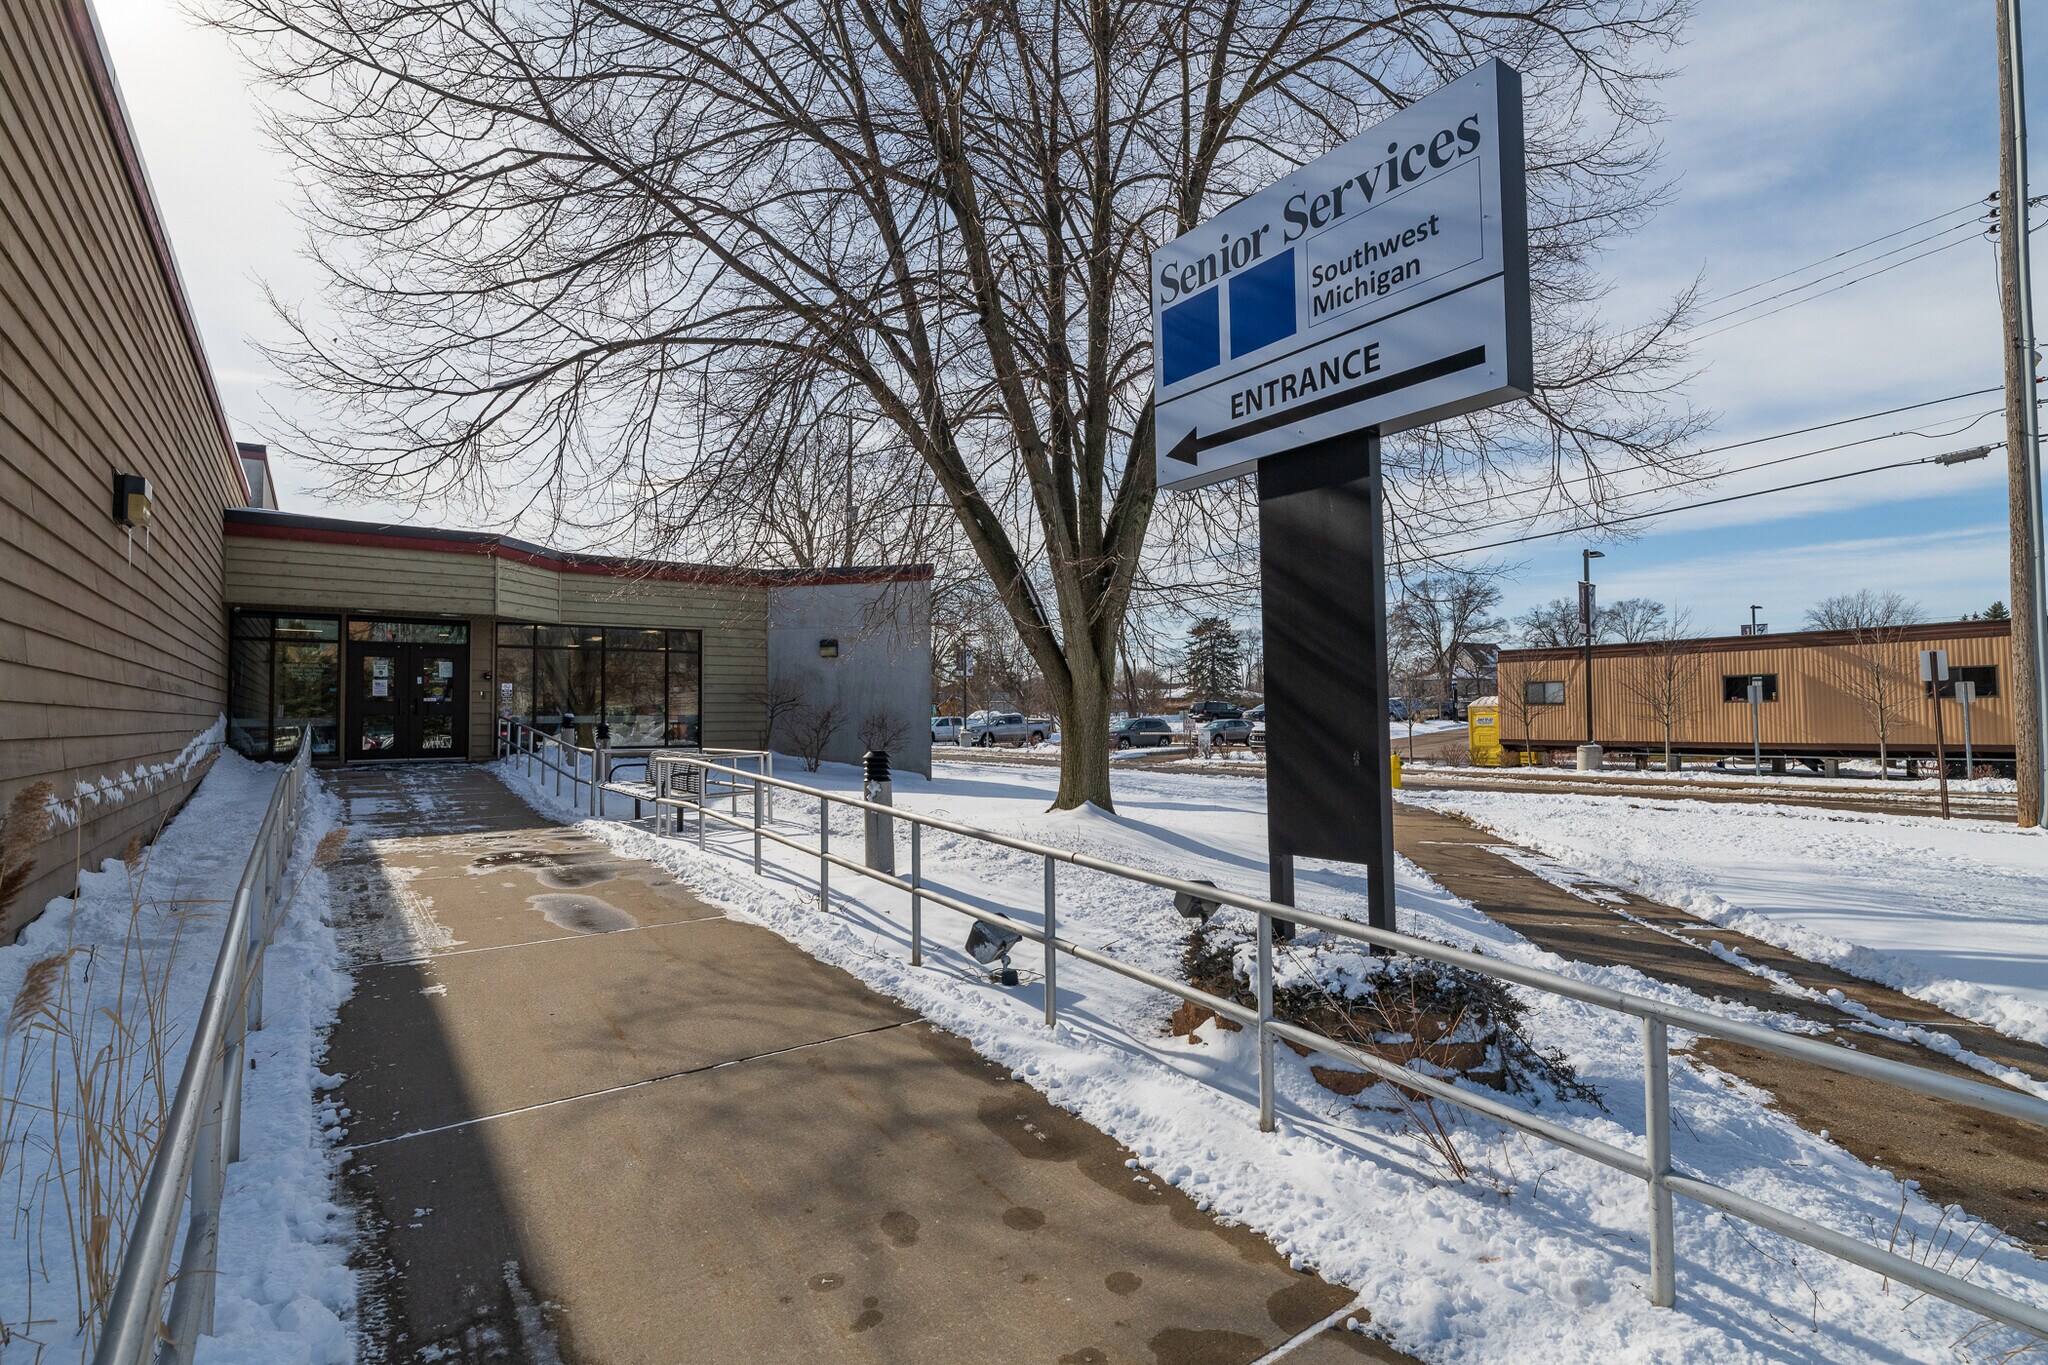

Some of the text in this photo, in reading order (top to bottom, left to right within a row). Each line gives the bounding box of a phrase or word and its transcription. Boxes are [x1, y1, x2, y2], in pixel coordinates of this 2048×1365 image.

[1160, 113, 1481, 306] Senior Services
[1312, 213, 1440, 289] Southwest
[1312, 257, 1421, 317] Michigan
[1231, 342, 1381, 420] ENTRANCE
